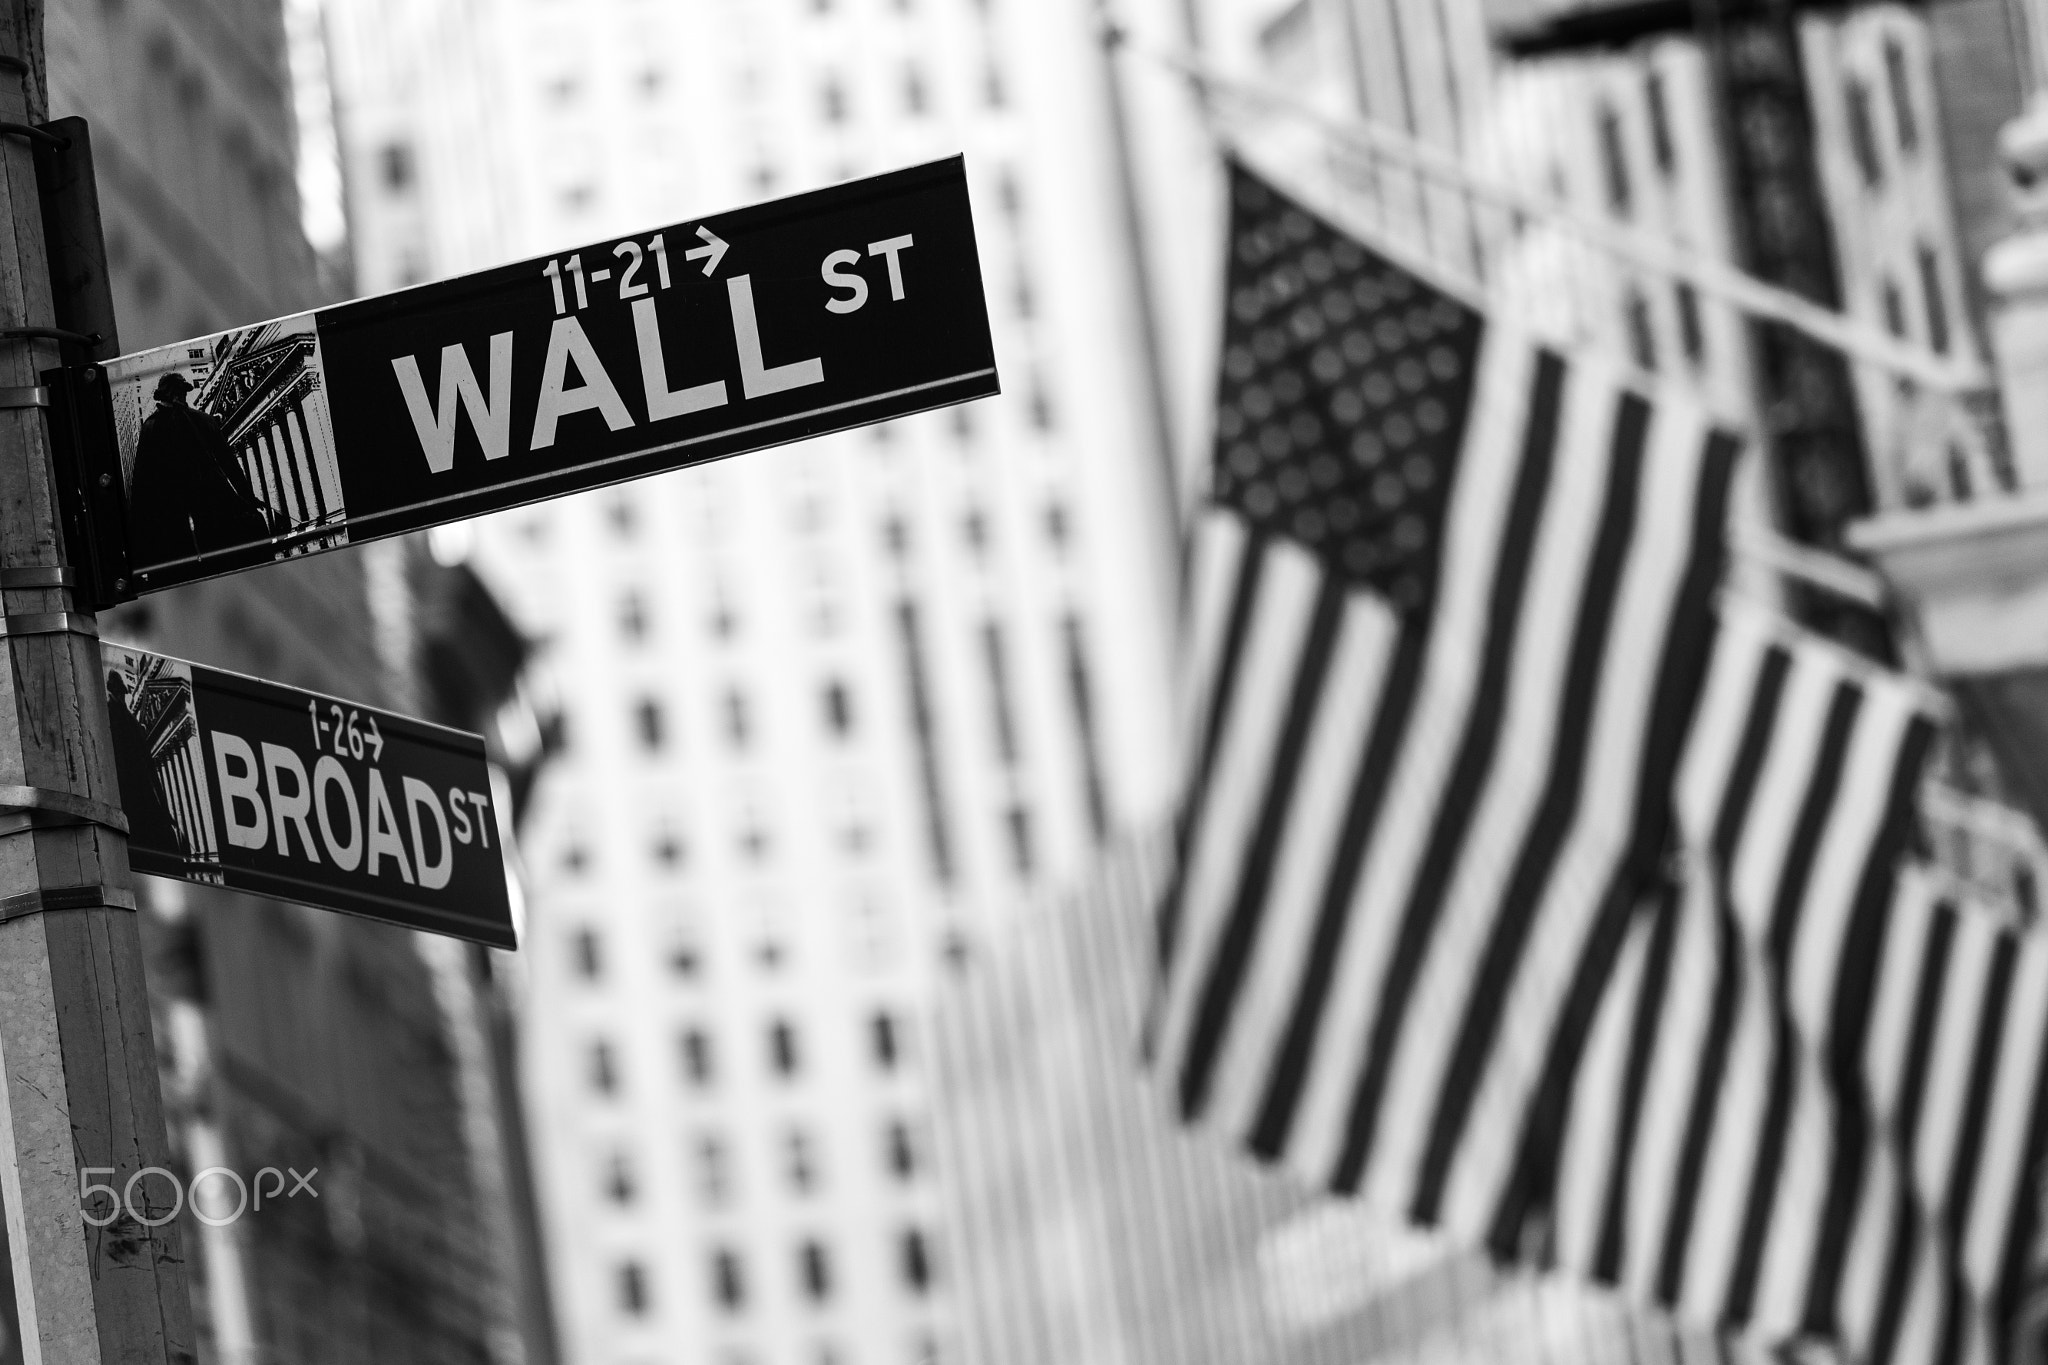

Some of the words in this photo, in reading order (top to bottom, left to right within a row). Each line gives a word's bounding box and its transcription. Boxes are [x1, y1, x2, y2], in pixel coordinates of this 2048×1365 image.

[543, 233, 671, 314] 11-21
[391, 273, 825, 475] WALL
[820, 233, 914, 315] ST
[308, 699, 364, 761] 1-26
[210, 730, 453, 890] BROAD
[448, 786, 489, 849] ST
